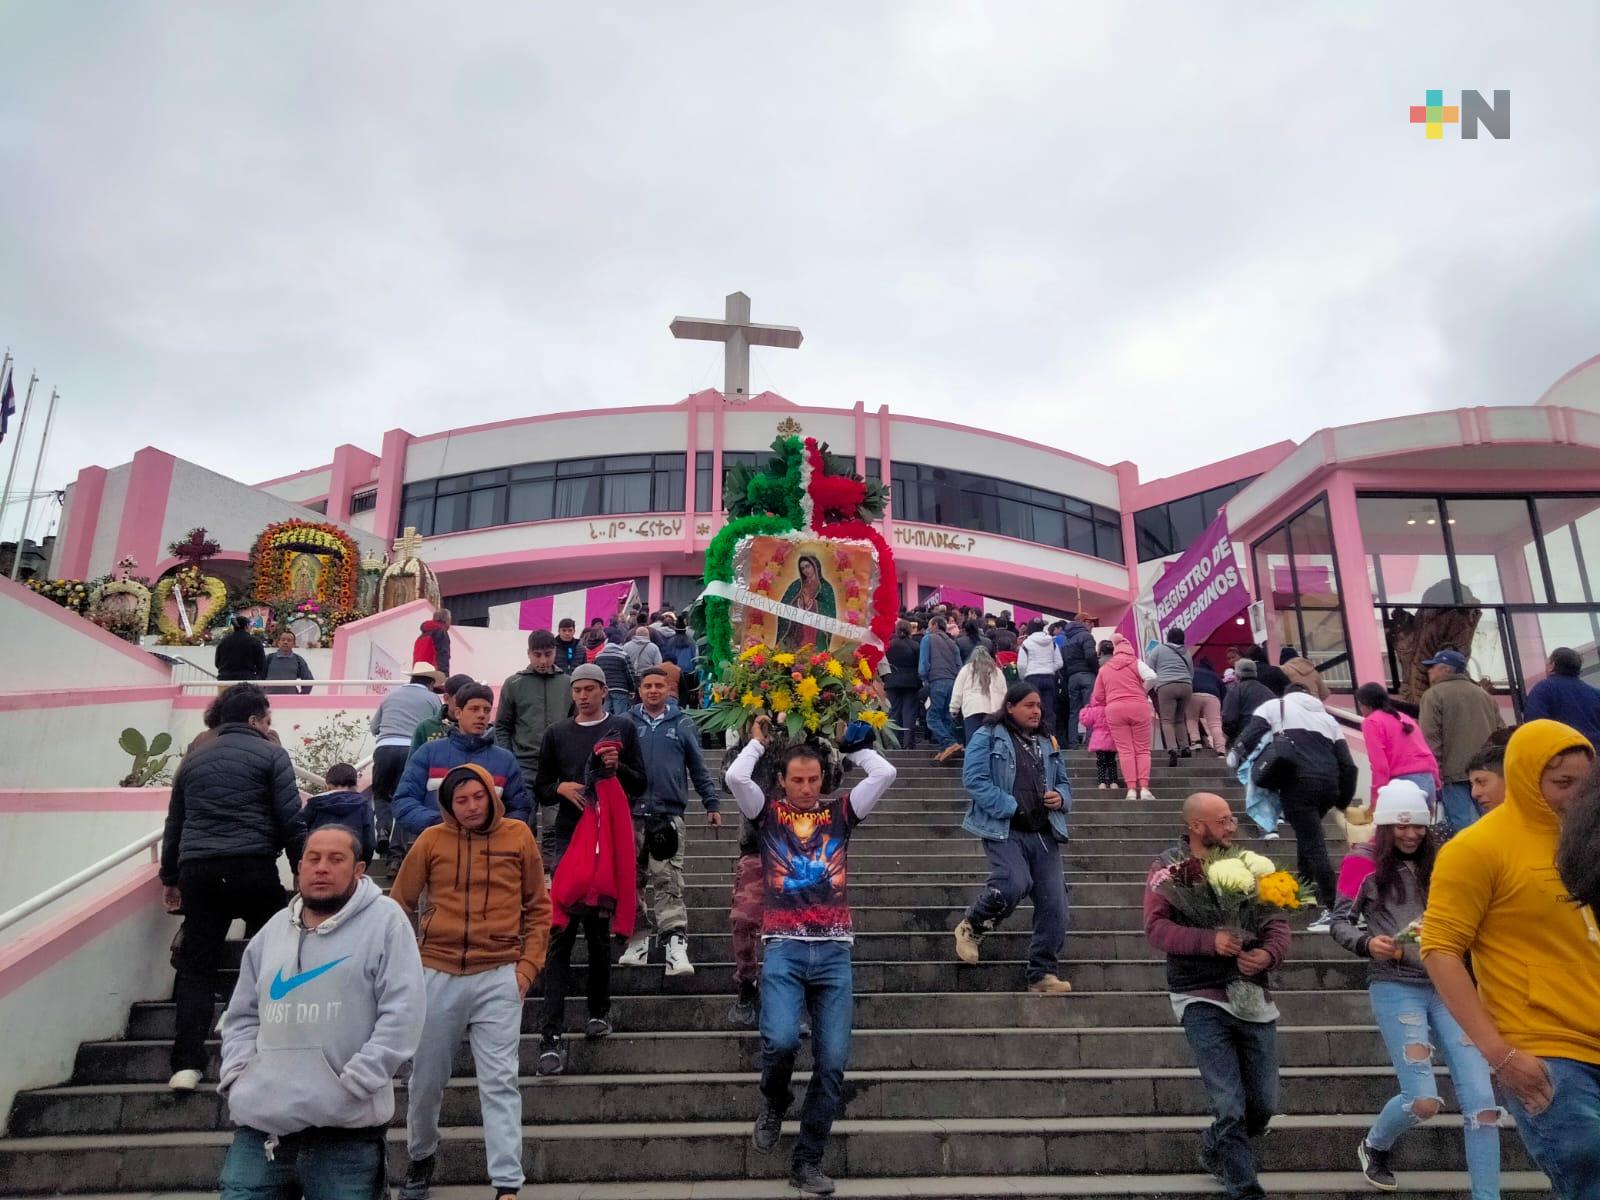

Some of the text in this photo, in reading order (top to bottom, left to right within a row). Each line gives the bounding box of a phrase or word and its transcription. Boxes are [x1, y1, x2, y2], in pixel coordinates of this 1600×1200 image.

[1157, 535, 1232, 621] REGISTRO DE
[296, 1003, 319, 1024] DO
[327, 1001, 342, 1021] IT
